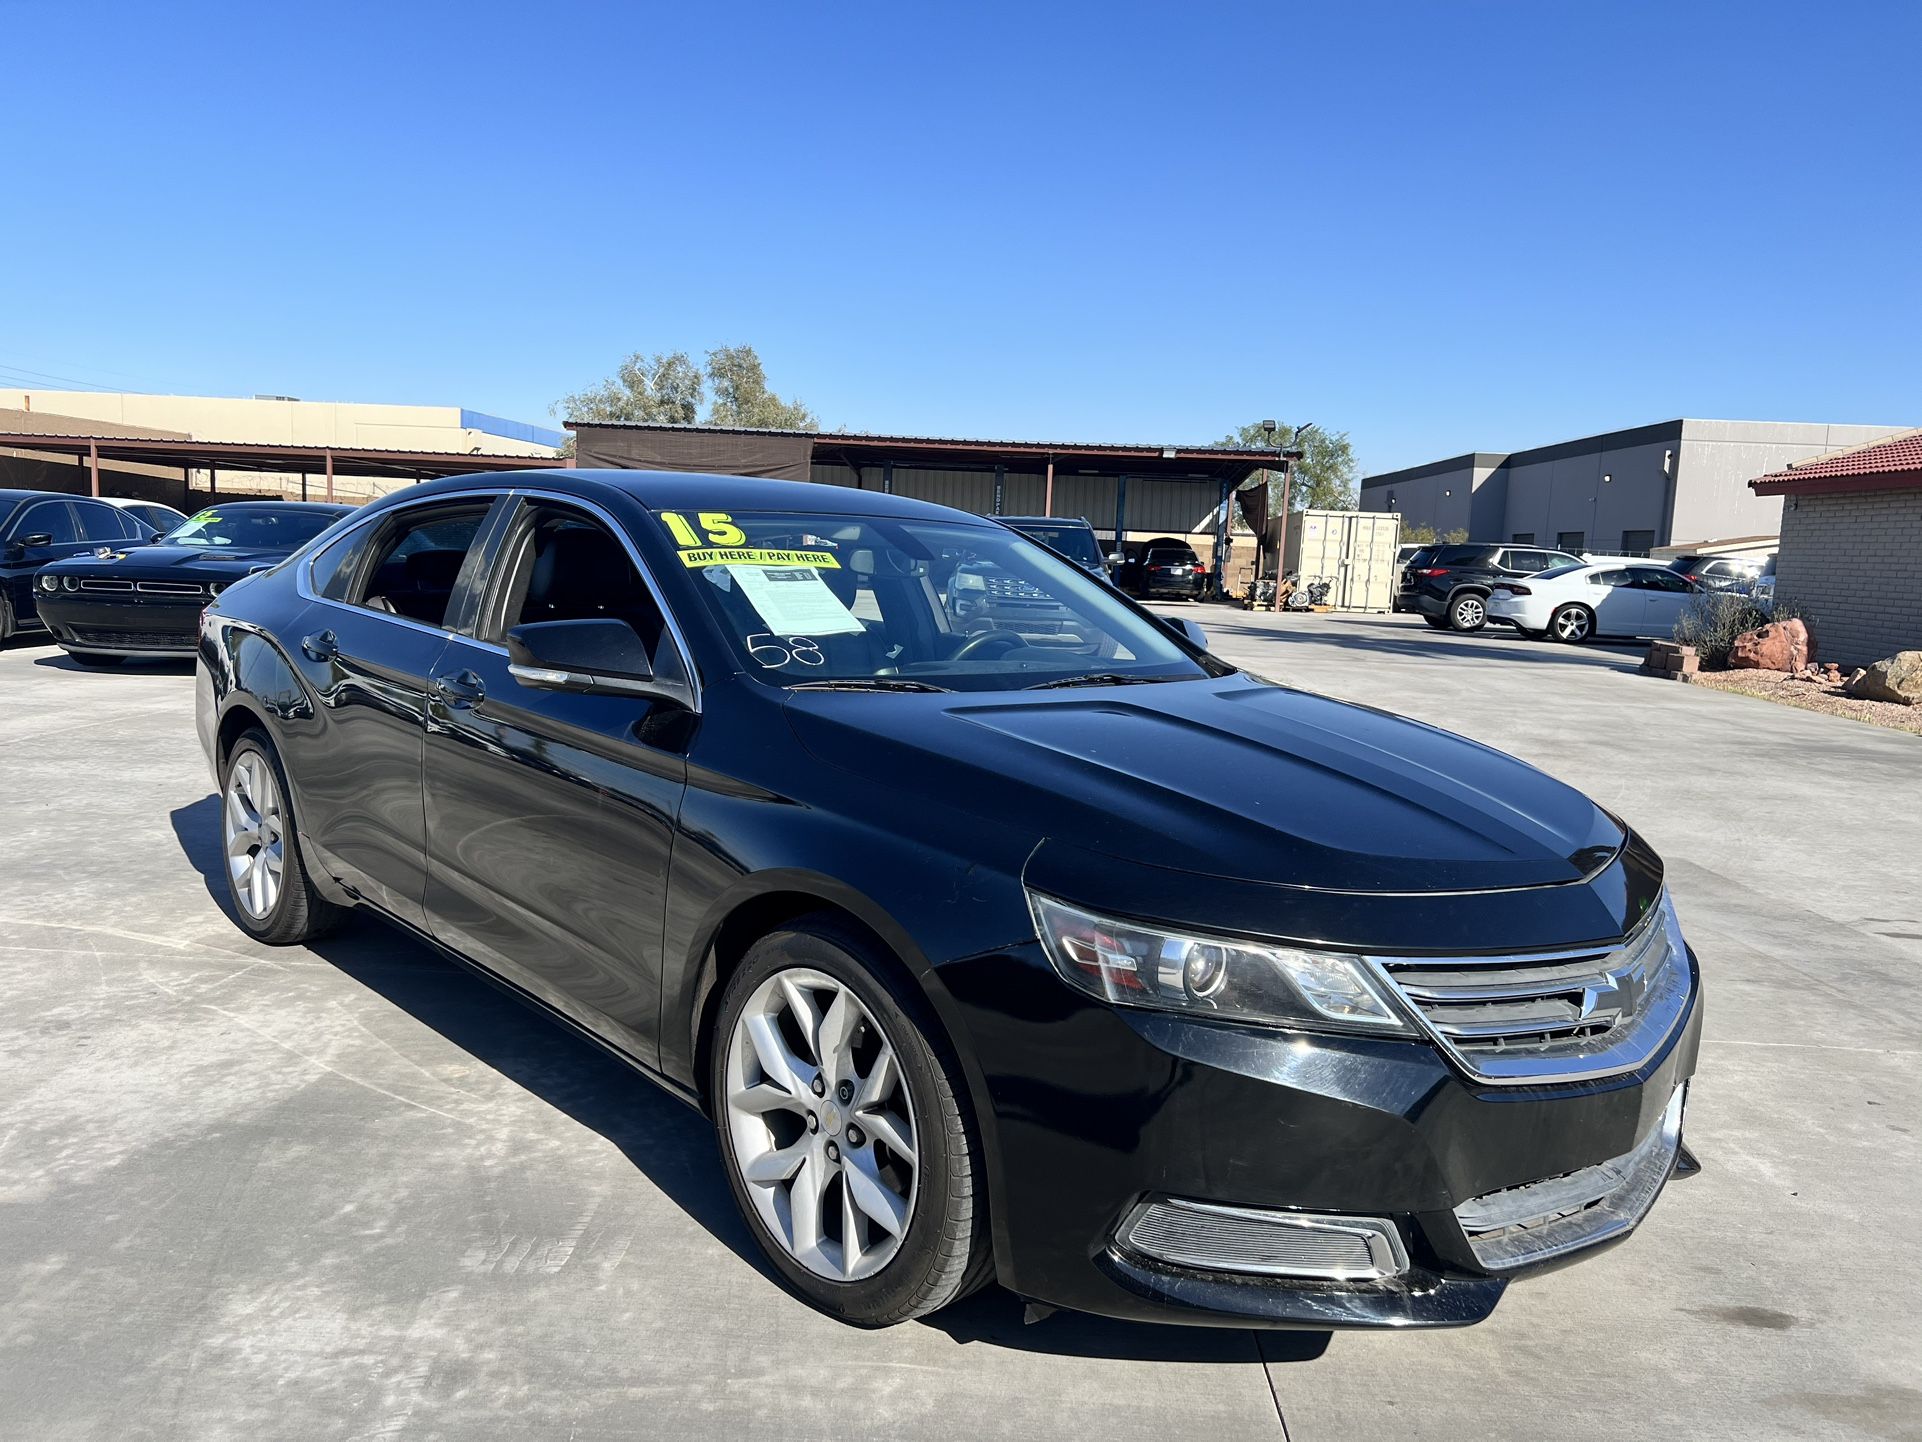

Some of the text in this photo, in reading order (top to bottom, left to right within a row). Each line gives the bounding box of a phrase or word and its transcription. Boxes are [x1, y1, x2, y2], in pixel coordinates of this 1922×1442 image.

[660, 512, 746, 546] 15
[688, 551, 714, 562] BUY
[719, 551, 755, 560] HERE
[768, 552, 792, 562] PAY
[796, 553, 829, 563] HERE
[747, 634, 824, 668] 58
